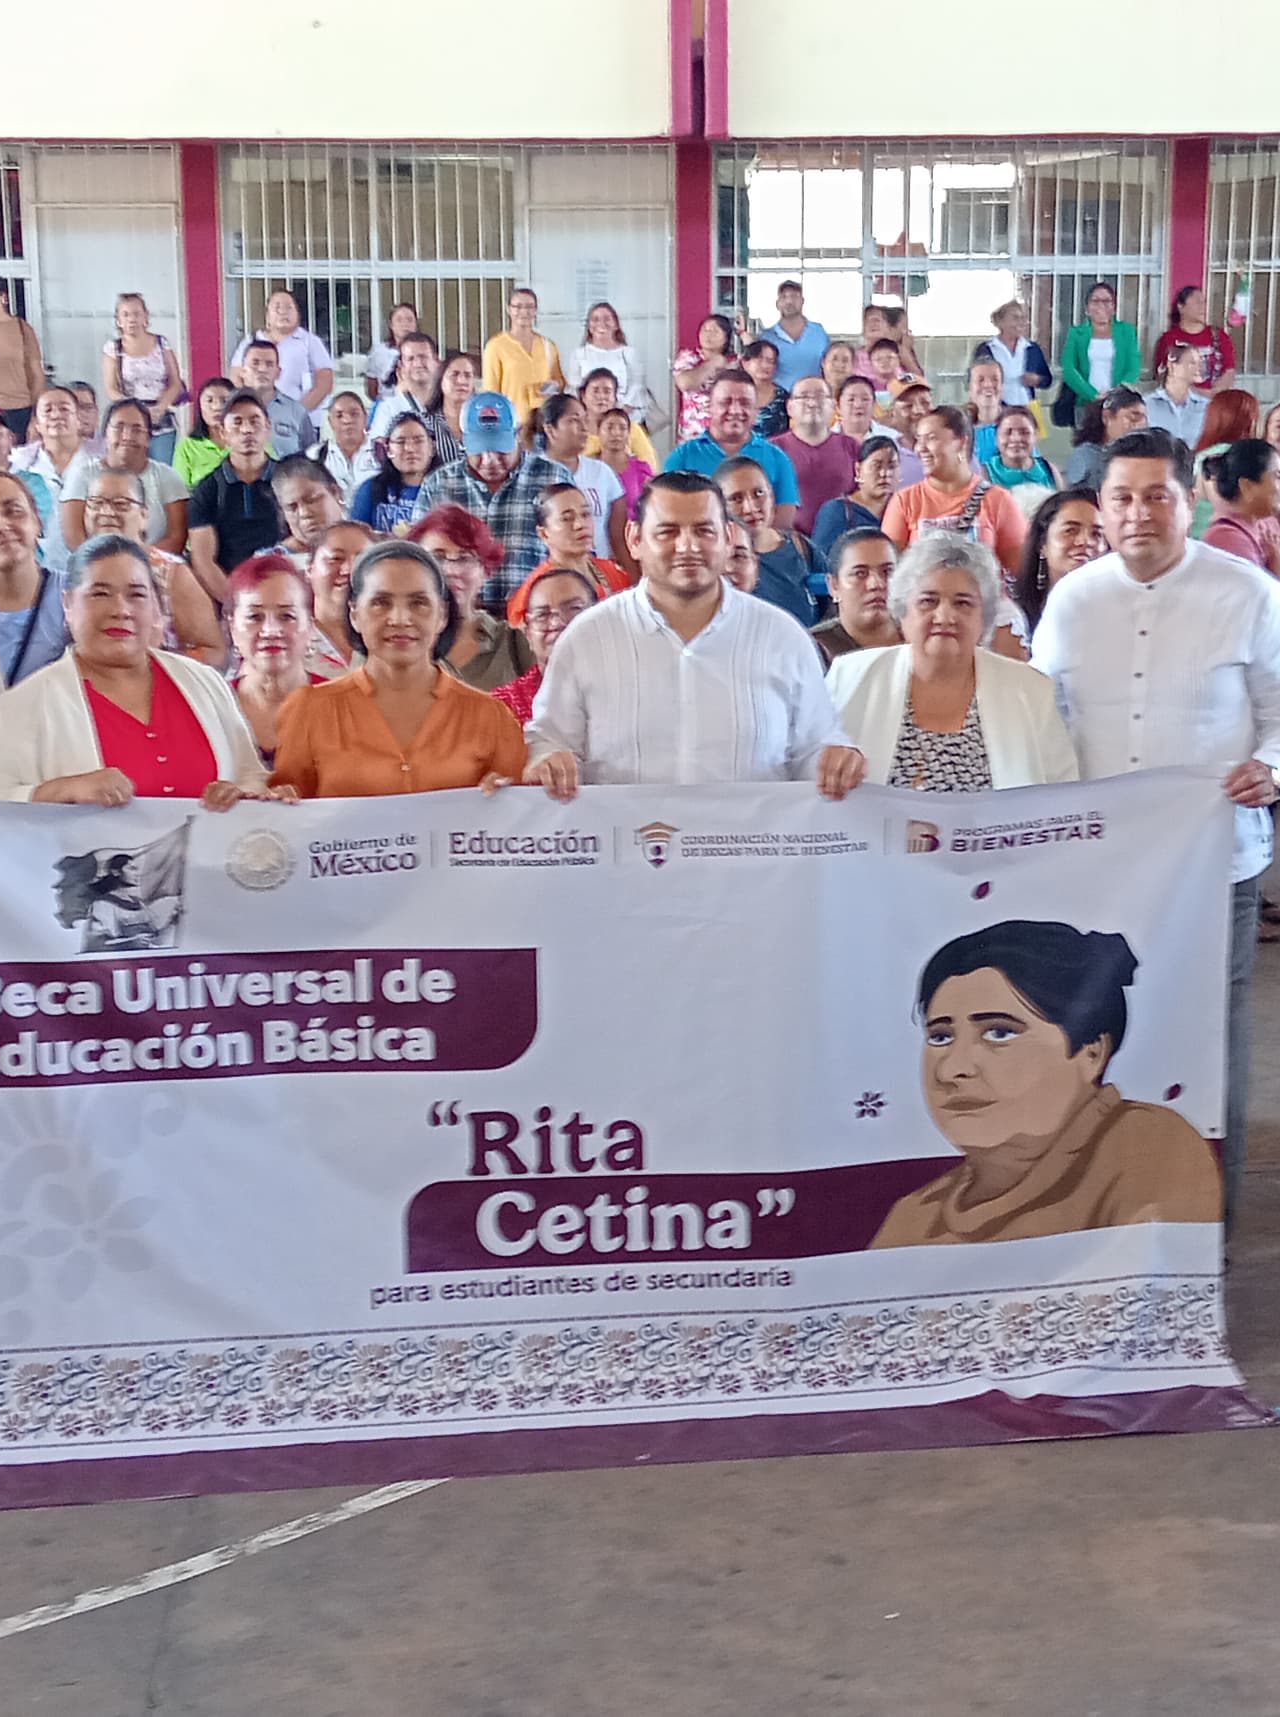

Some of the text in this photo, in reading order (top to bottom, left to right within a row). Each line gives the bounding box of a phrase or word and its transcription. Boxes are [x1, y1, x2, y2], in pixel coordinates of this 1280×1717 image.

[950, 822, 1104, 853] BIENESTAR
[952, 810, 1106, 837] PROGRAMAS PARA EL
[308, 833, 417, 854] Gobierno de
[448, 829, 600, 855] Educación
[680, 831, 849, 846] COORDINACIÓN NACIONAL
[682, 841, 869, 858] DE BECAS PARA EL BIENESTAR
[309, 850, 418, 878] México
[111, 958, 374, 1014] Universal
[380, 957, 457, 1004] de
[261, 1014, 438, 1065] Básica
[426, 1100, 646, 1177] “Rita
[475, 1184, 797, 1257] Cetina”
[369, 1282, 433, 1309] para
[439, 1273, 597, 1302] estudiantes
[603, 1270, 640, 1292] de
